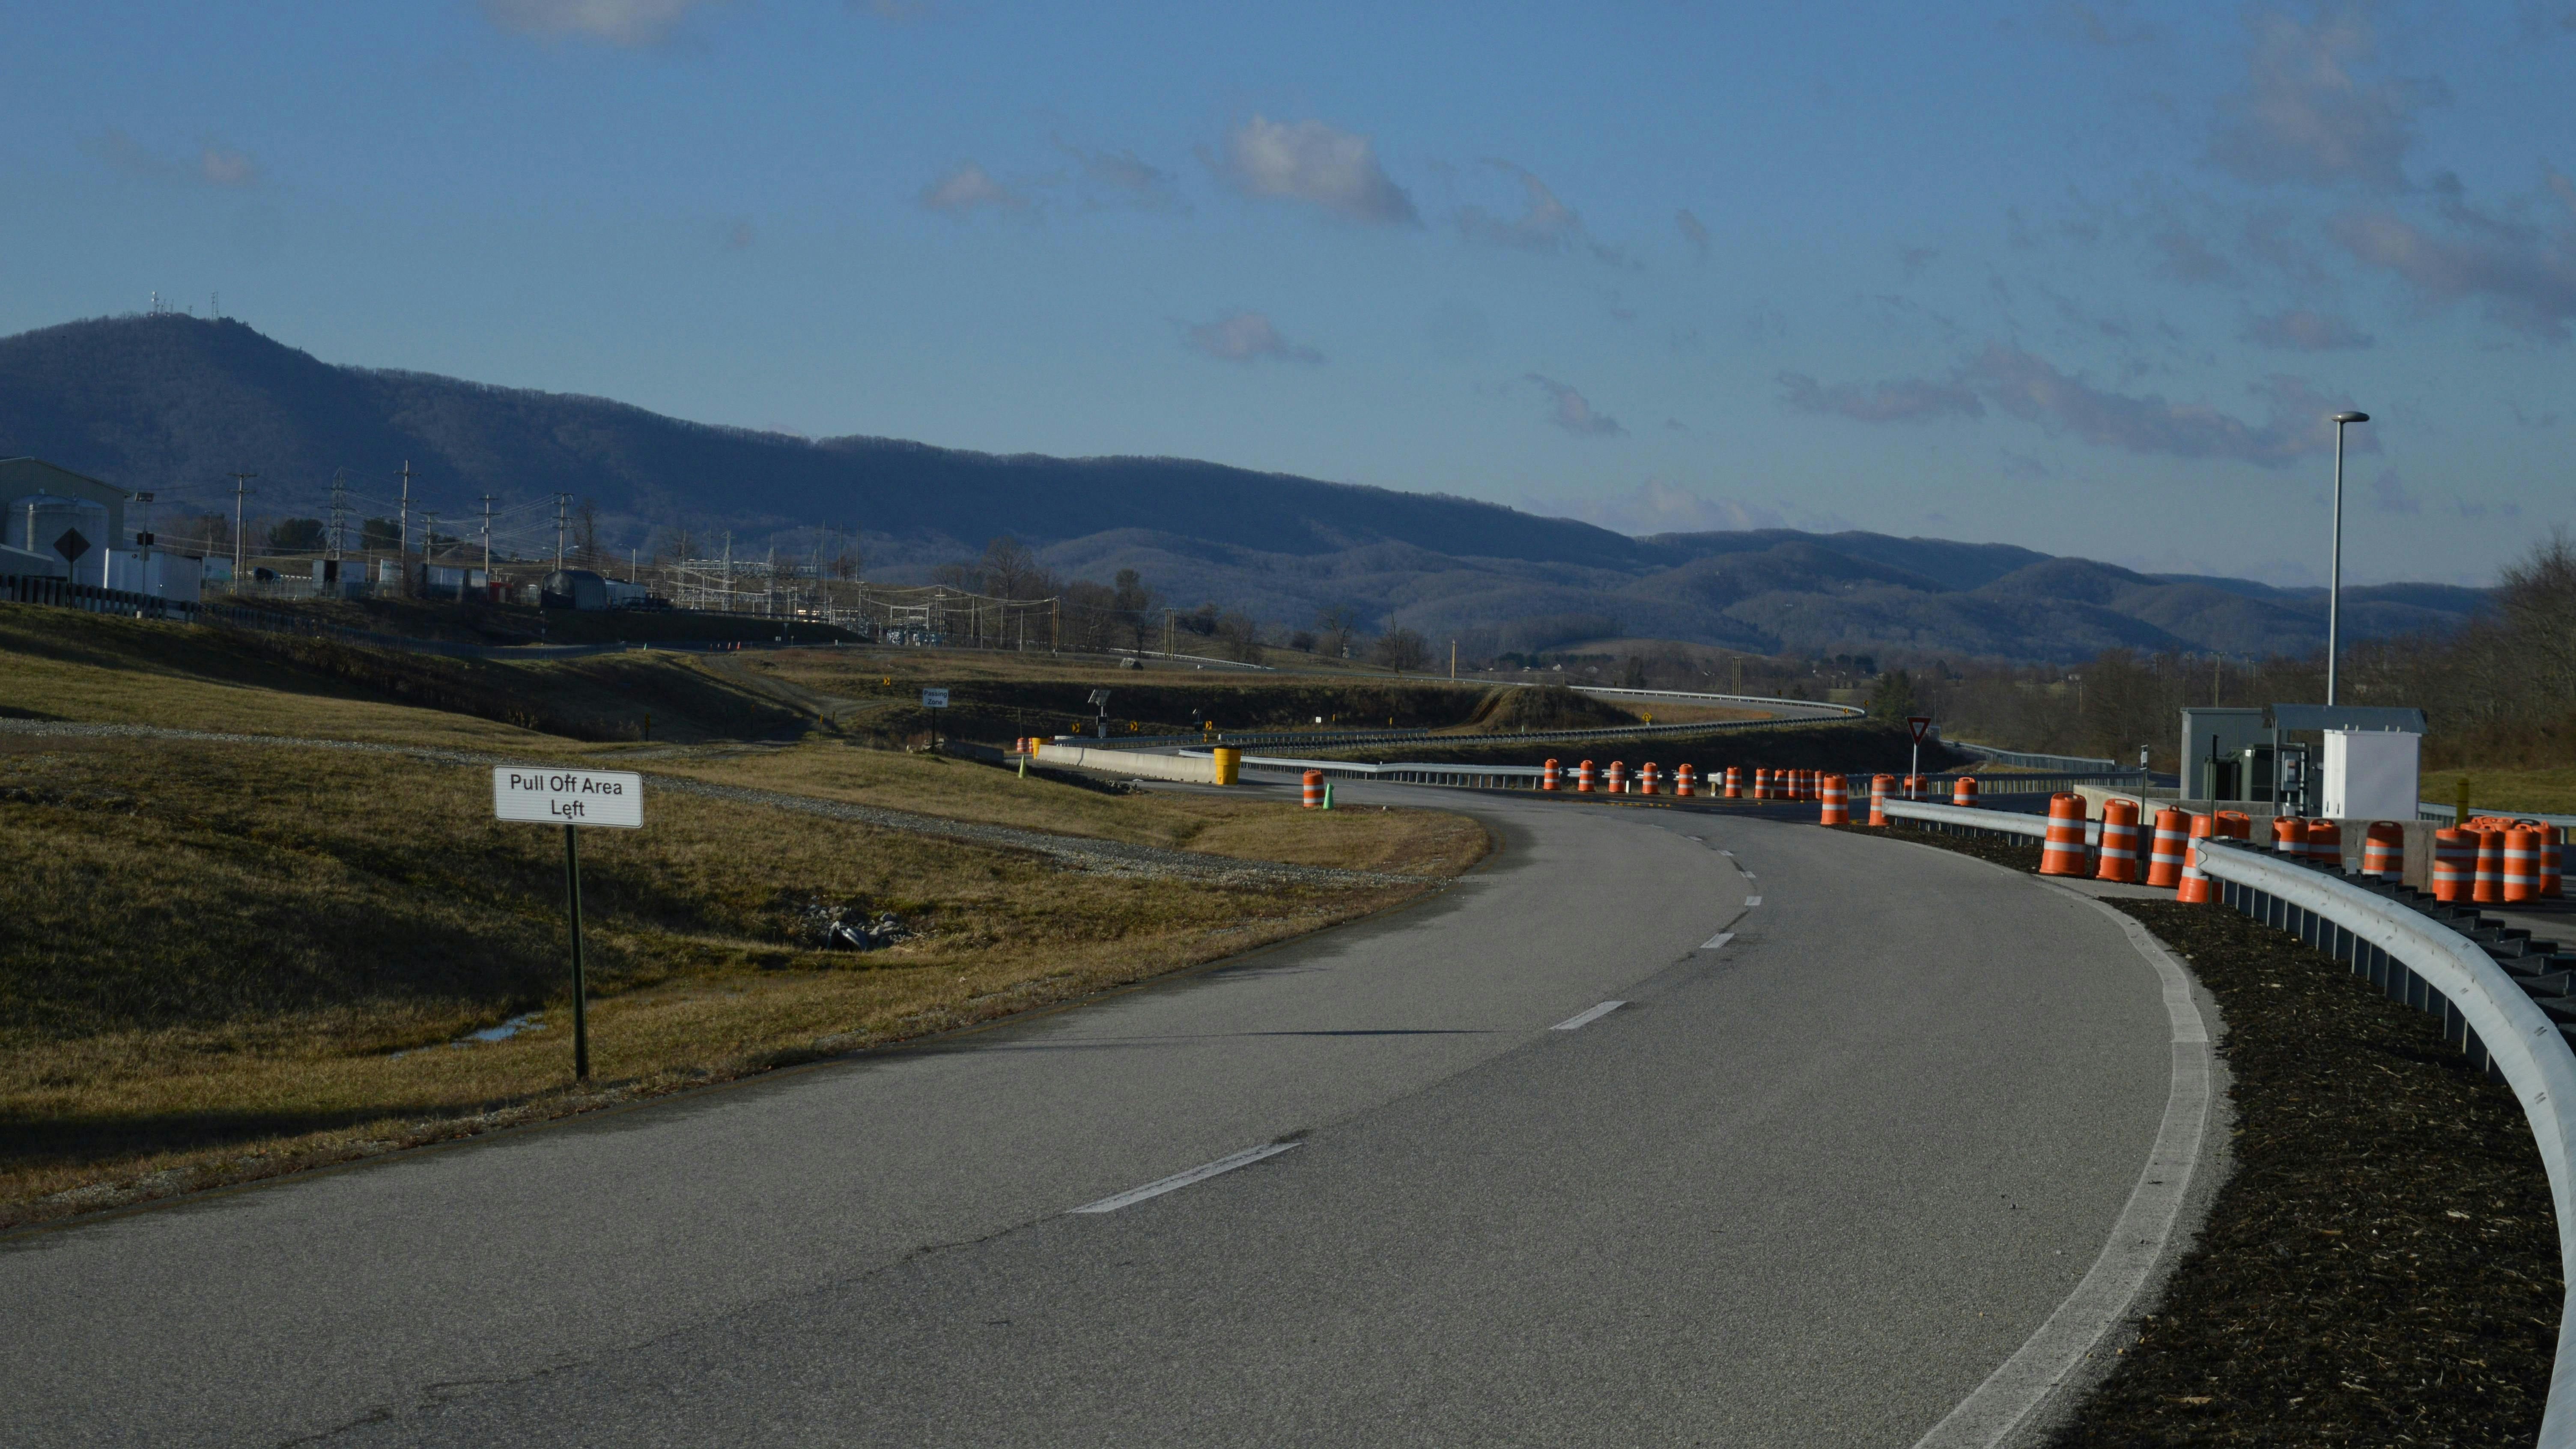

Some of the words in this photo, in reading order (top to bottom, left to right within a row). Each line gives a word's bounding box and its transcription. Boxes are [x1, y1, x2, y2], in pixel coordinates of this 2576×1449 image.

[510, 774, 544, 790] Pull
[550, 775, 577, 792] Off
[582, 778, 622, 795] Area
[552, 799, 585, 816] Left
